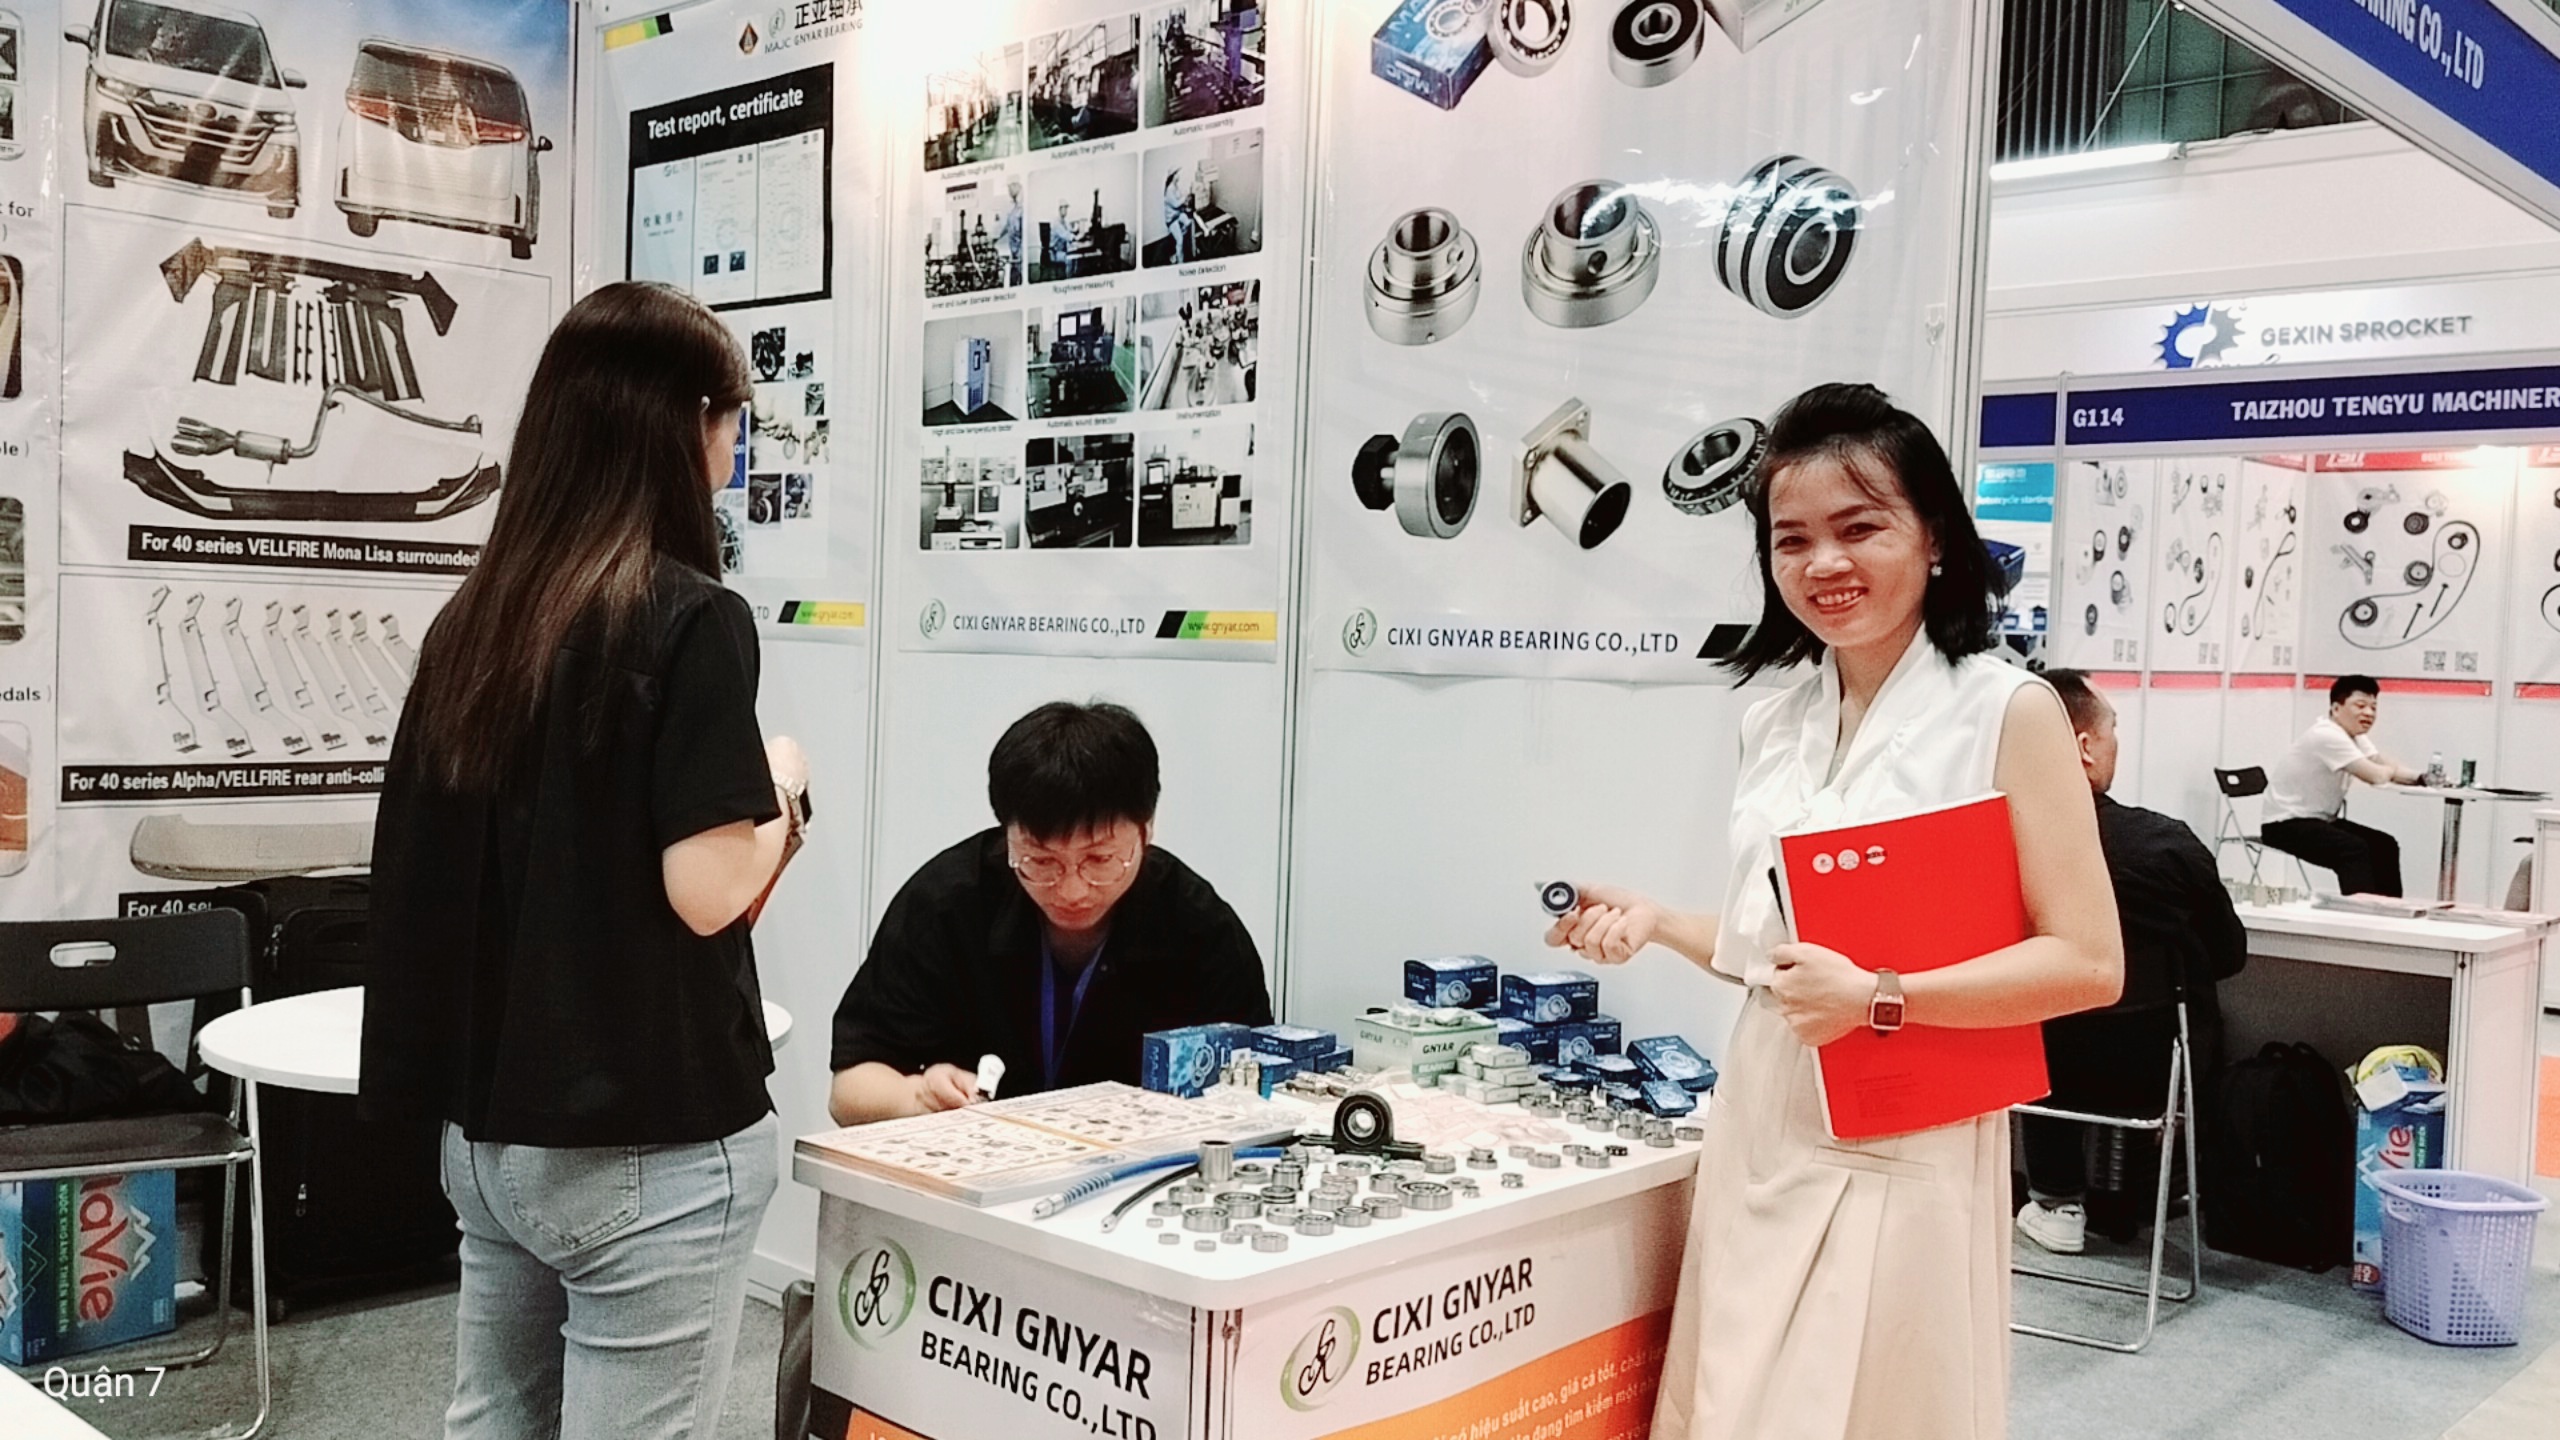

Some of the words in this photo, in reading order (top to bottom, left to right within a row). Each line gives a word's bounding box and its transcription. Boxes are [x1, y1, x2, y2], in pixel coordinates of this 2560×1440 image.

[2419, 4, 2485, 90] CO.,LTD
[648, 117, 676, 139] Test
[678, 106, 726, 134] report,
[729, 88, 804, 121] certificate
[8, 201, 35, 218] for
[2261, 323, 2334, 347] GEXIN
[2339, 315, 2473, 344] SPROCKET
[2072, 407, 2125, 430] G114
[2231, 397, 2325, 422] TAIZHOU
[2332, 394, 2424, 418] TENGYU
[2432, 387, 2560, 414] MACHINER
[141, 532, 168, 551] For
[172, 535, 193, 552] 40
[195, 537, 244, 555] series
[247, 538, 320, 559] VELLFIRE
[323, 542, 362, 561] Mona
[365, 545, 393, 564] Lisa
[396, 549, 481, 567] surrounded
[953, 615, 979, 632] CIXI
[982, 615, 1026, 633] GNYAR
[1029, 616, 1088, 634] BEARING
[1091, 616, 1145, 637] CO.,LTD
[1387, 627, 1423, 647] CIXI
[1428, 628, 1495, 649] GNYAR
[1499, 630, 1591, 651] BEARING
[1595, 632, 1679, 657] CO.,LTD
[0, 686, 42, 702] dals
[69, 772, 95, 790] For
[99, 772, 119, 790] 40
[122, 771, 169, 790] series
[171, 769, 291, 792] Alpha/VELLFIRE
[294, 770, 323, 786] rear
[127, 901, 157, 918] For
[161, 899, 184, 914] 40
[1372, 1294, 1433, 1345] CIXI
[1444, 1257, 1533, 1321] GNYAR
[929, 1275, 1003, 1337] CIXI
[1015, 1306, 1152, 1400] GNYAR
[1366, 1331, 1463, 1386] BEARING
[1469, 1303, 1536, 1349] CO.,LTD
[921, 1330, 1039, 1403] BEARING
[1046, 1381, 1157, 1440] CO.,LTD
